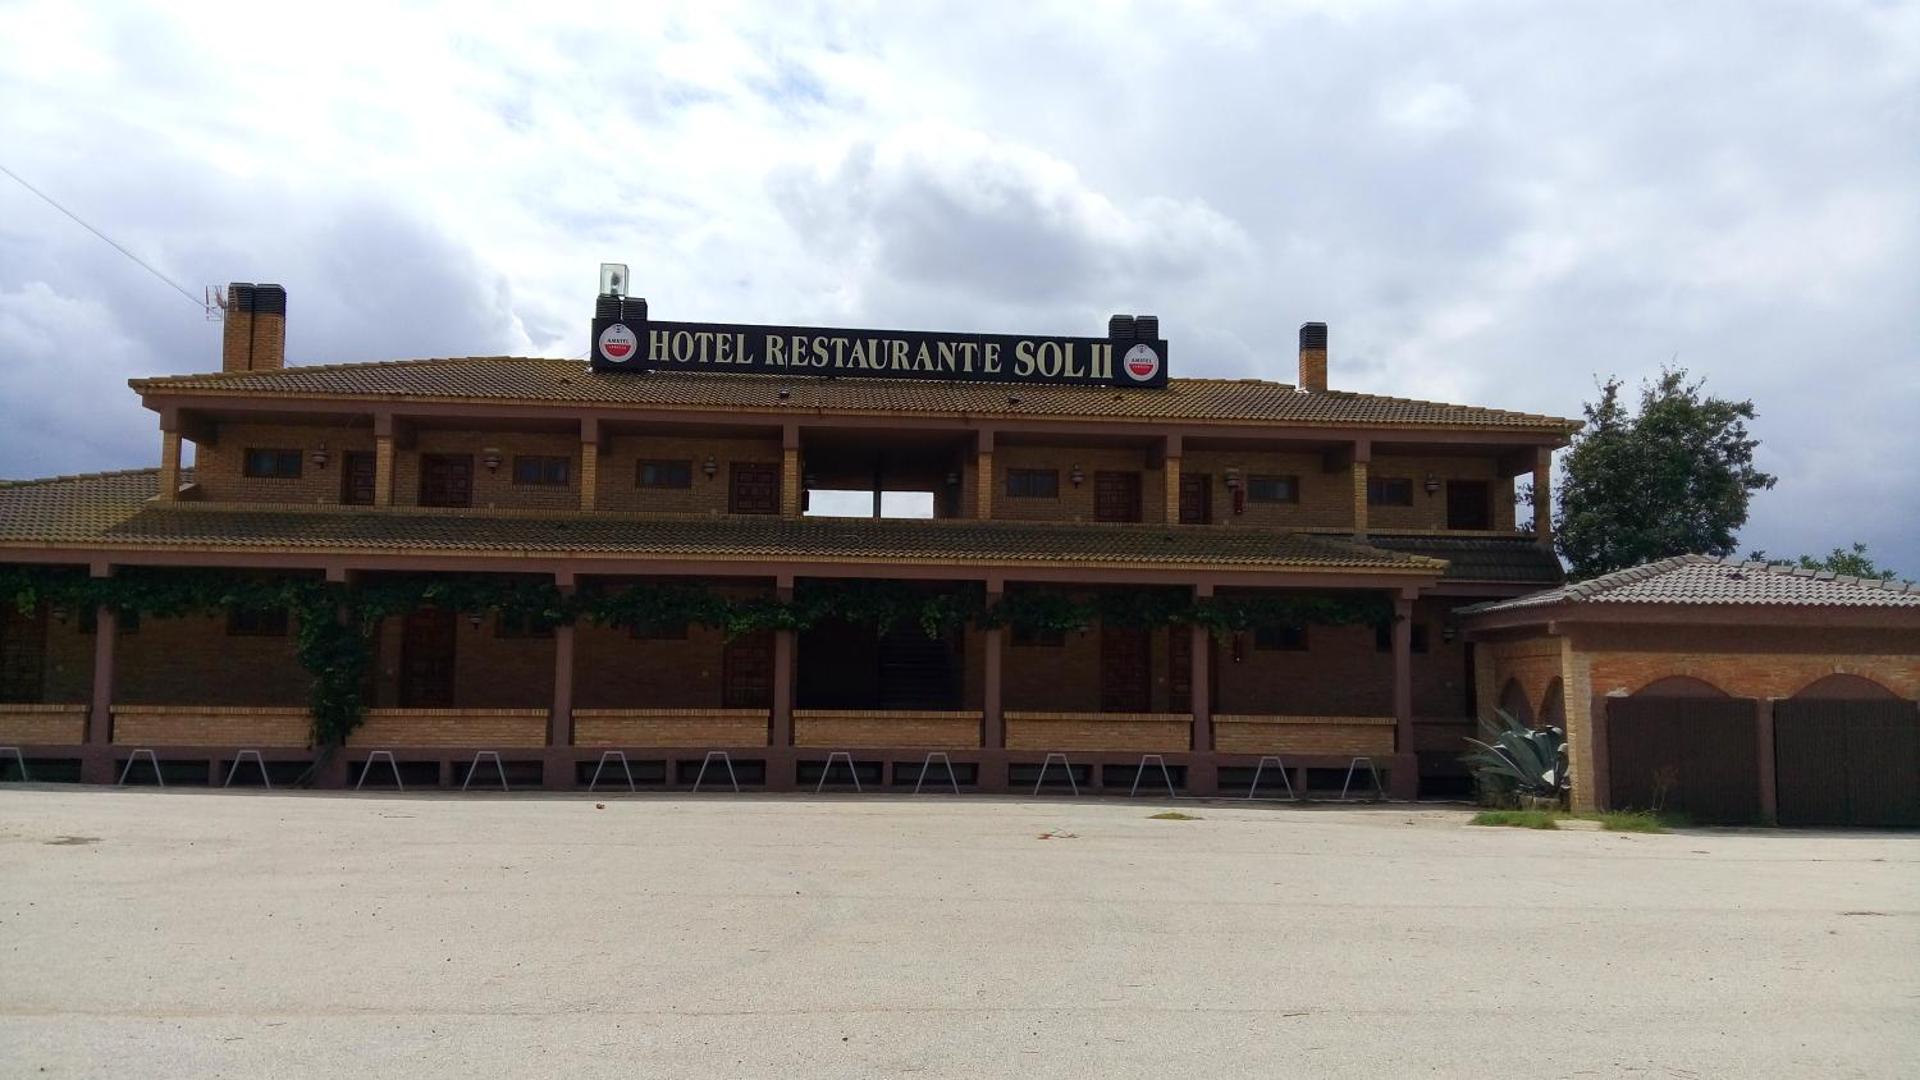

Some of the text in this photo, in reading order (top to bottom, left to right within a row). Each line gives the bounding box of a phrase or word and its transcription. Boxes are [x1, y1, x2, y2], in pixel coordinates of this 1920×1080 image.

[648, 330, 1113, 379] HOTEL RESTAURANTE SOL II
